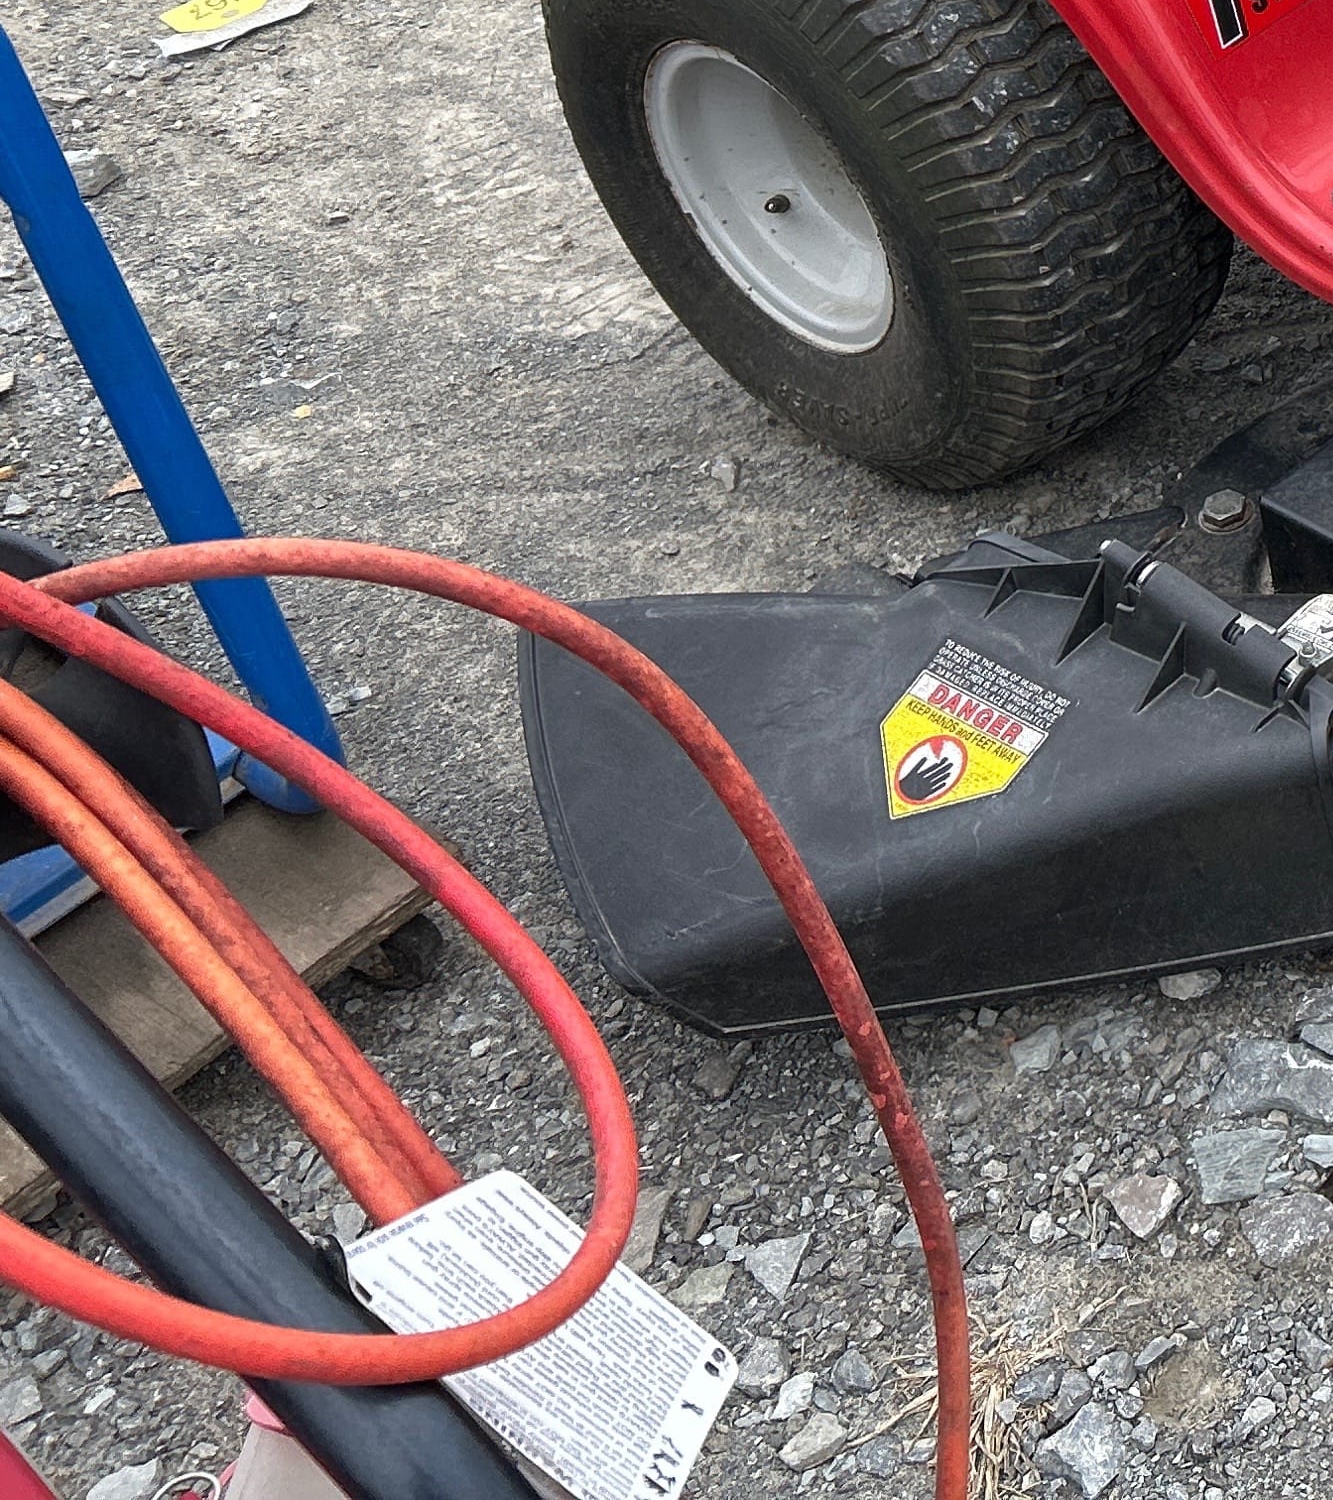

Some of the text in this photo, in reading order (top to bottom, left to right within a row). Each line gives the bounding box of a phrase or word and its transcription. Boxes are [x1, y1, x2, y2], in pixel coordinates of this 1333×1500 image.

[952, 643, 982, 663] REDUCE
[905, 698, 1021, 765] KEEP HANDS and FEET AWAY
[926, 682, 1025, 746] DANGER
